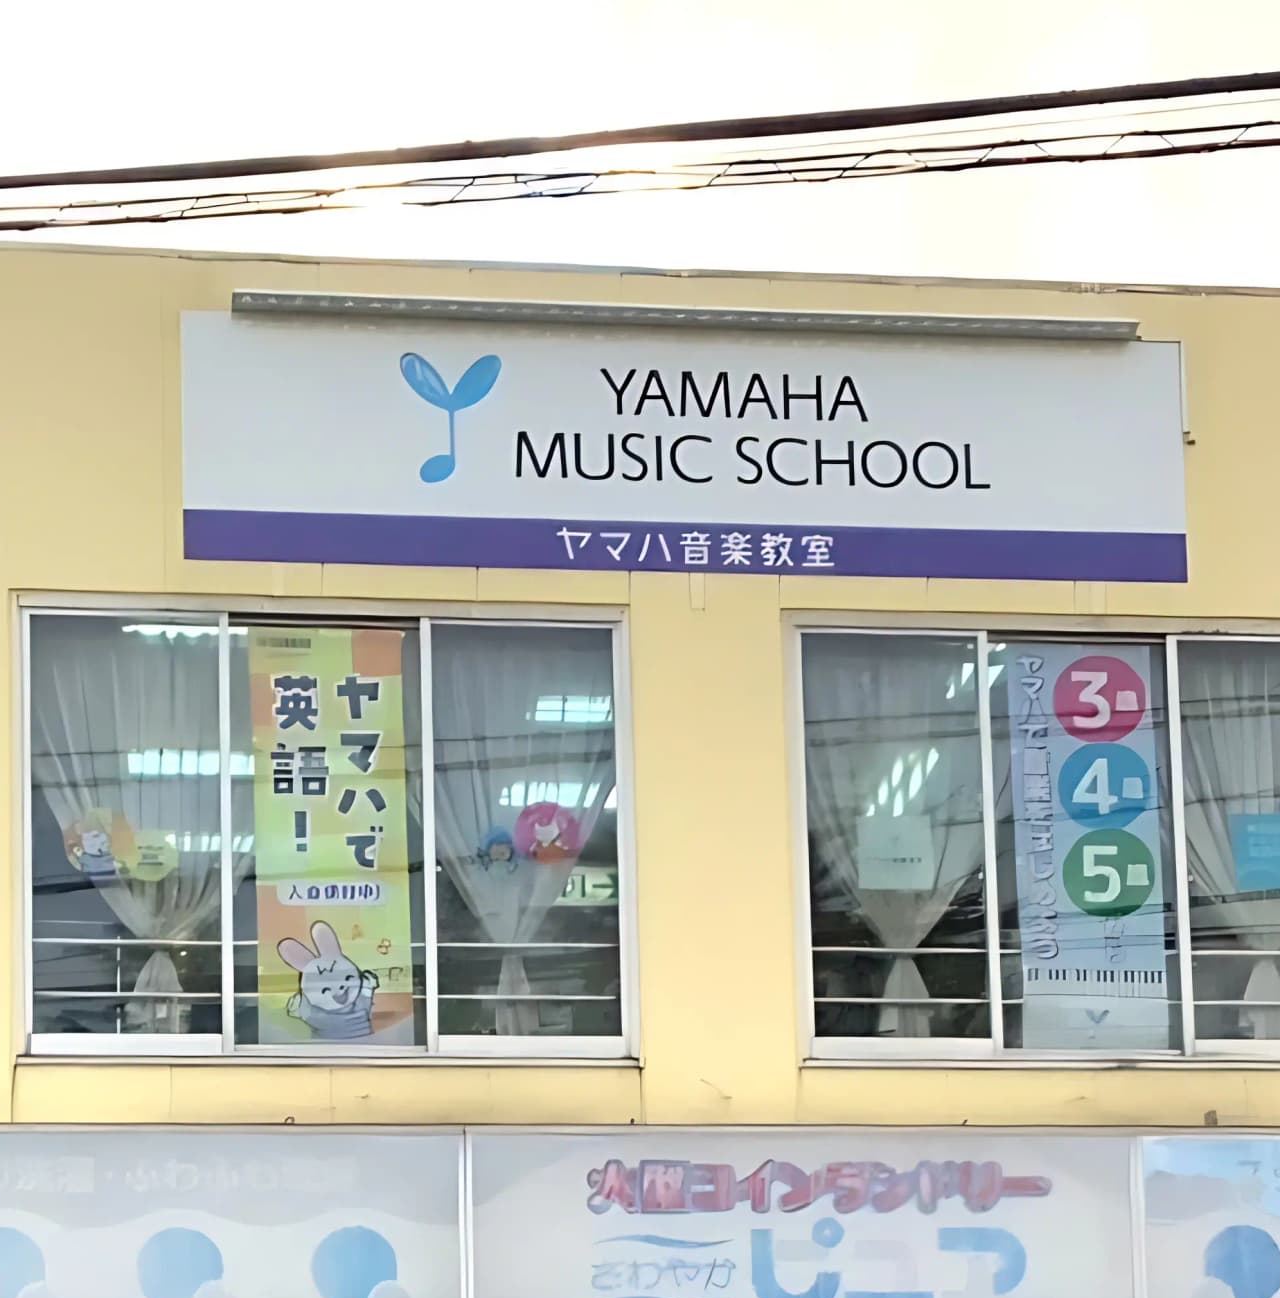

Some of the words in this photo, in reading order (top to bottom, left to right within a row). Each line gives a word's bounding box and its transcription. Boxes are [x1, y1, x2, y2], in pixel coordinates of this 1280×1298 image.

[599, 368, 869, 423] YAMAHA
[513, 430, 714, 485] MUSIC
[734, 435, 991, 490] SCHOOL
[555, 525, 836, 568] ヤマハ音楽教室
[1070, 670, 1138, 729] 3
[270, 675, 329, 852] 英語!
[336, 675, 387, 869] ヤマハで
[1071, 757, 1144, 815] 4
[1081, 844, 1150, 903] 5
[591, 1258, 737, 1291] さわやか
